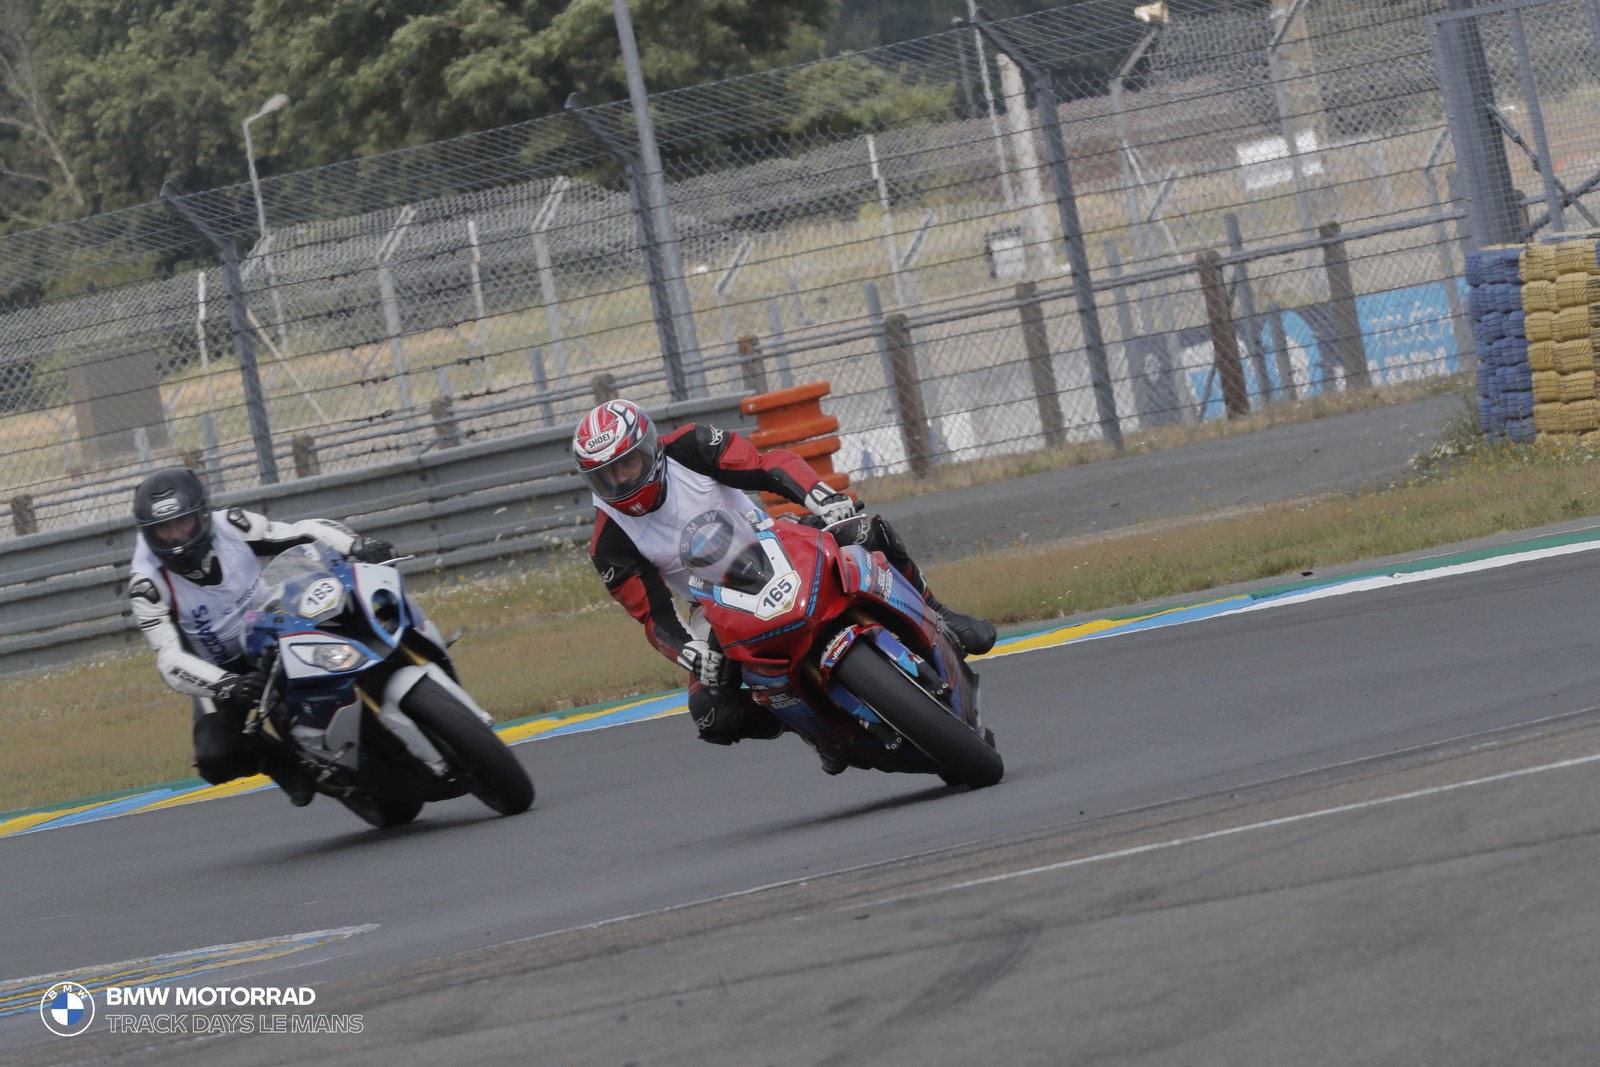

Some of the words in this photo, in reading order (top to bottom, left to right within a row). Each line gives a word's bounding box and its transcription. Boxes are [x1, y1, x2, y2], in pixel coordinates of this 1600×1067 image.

[588, 433, 610, 449] SHOEI
[680, 511, 717, 553] BMW
[762, 578, 793, 609] 165
